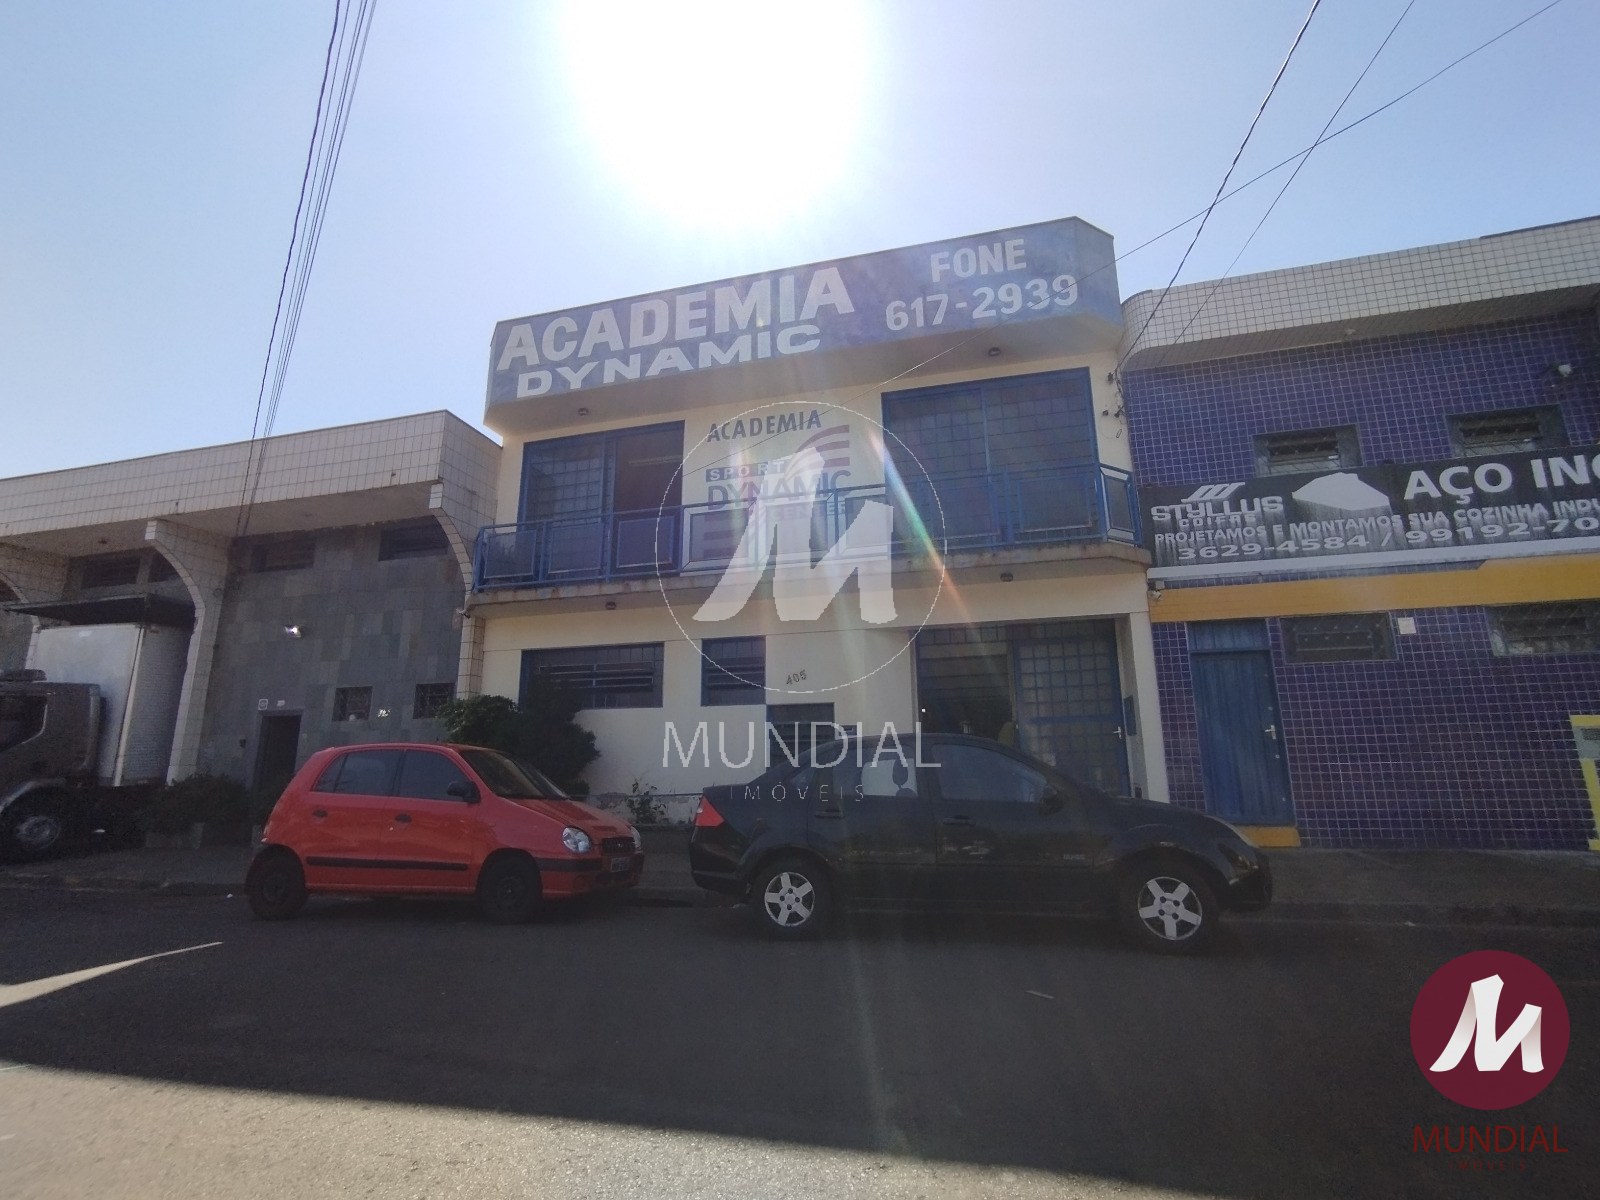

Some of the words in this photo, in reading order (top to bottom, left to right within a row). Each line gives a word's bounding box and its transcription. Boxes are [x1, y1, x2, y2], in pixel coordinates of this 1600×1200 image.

[930, 239, 1026, 282] FONE
[496, 266, 855, 371] ACADEMIA
[886, 274, 1078, 331] 617-2939
[516, 324, 820, 399] DYNAMIC
[707, 410, 822, 442] ACADEMIA
[708, 469, 852, 511] DYNAMIC
[709, 460, 785, 481] SPORT
[1404, 463, 1513, 505] AÇO
[1530, 453, 1600, 488] IN
[1151, 496, 1284, 521] STYLLUS
[1155, 526, 1266, 543] PROJETAMOS
[1273, 524, 1283, 538] E
[1289, 514, 1402, 539] MONTAMOS
[1408, 510, 1449, 528] SUA
[1453, 502, 1549, 526] COZINHA
[1179, 535, 1370, 560] 3629-4584
[1405, 516, 1600, 544] 99192-70
[786, 668, 807, 685] 405
